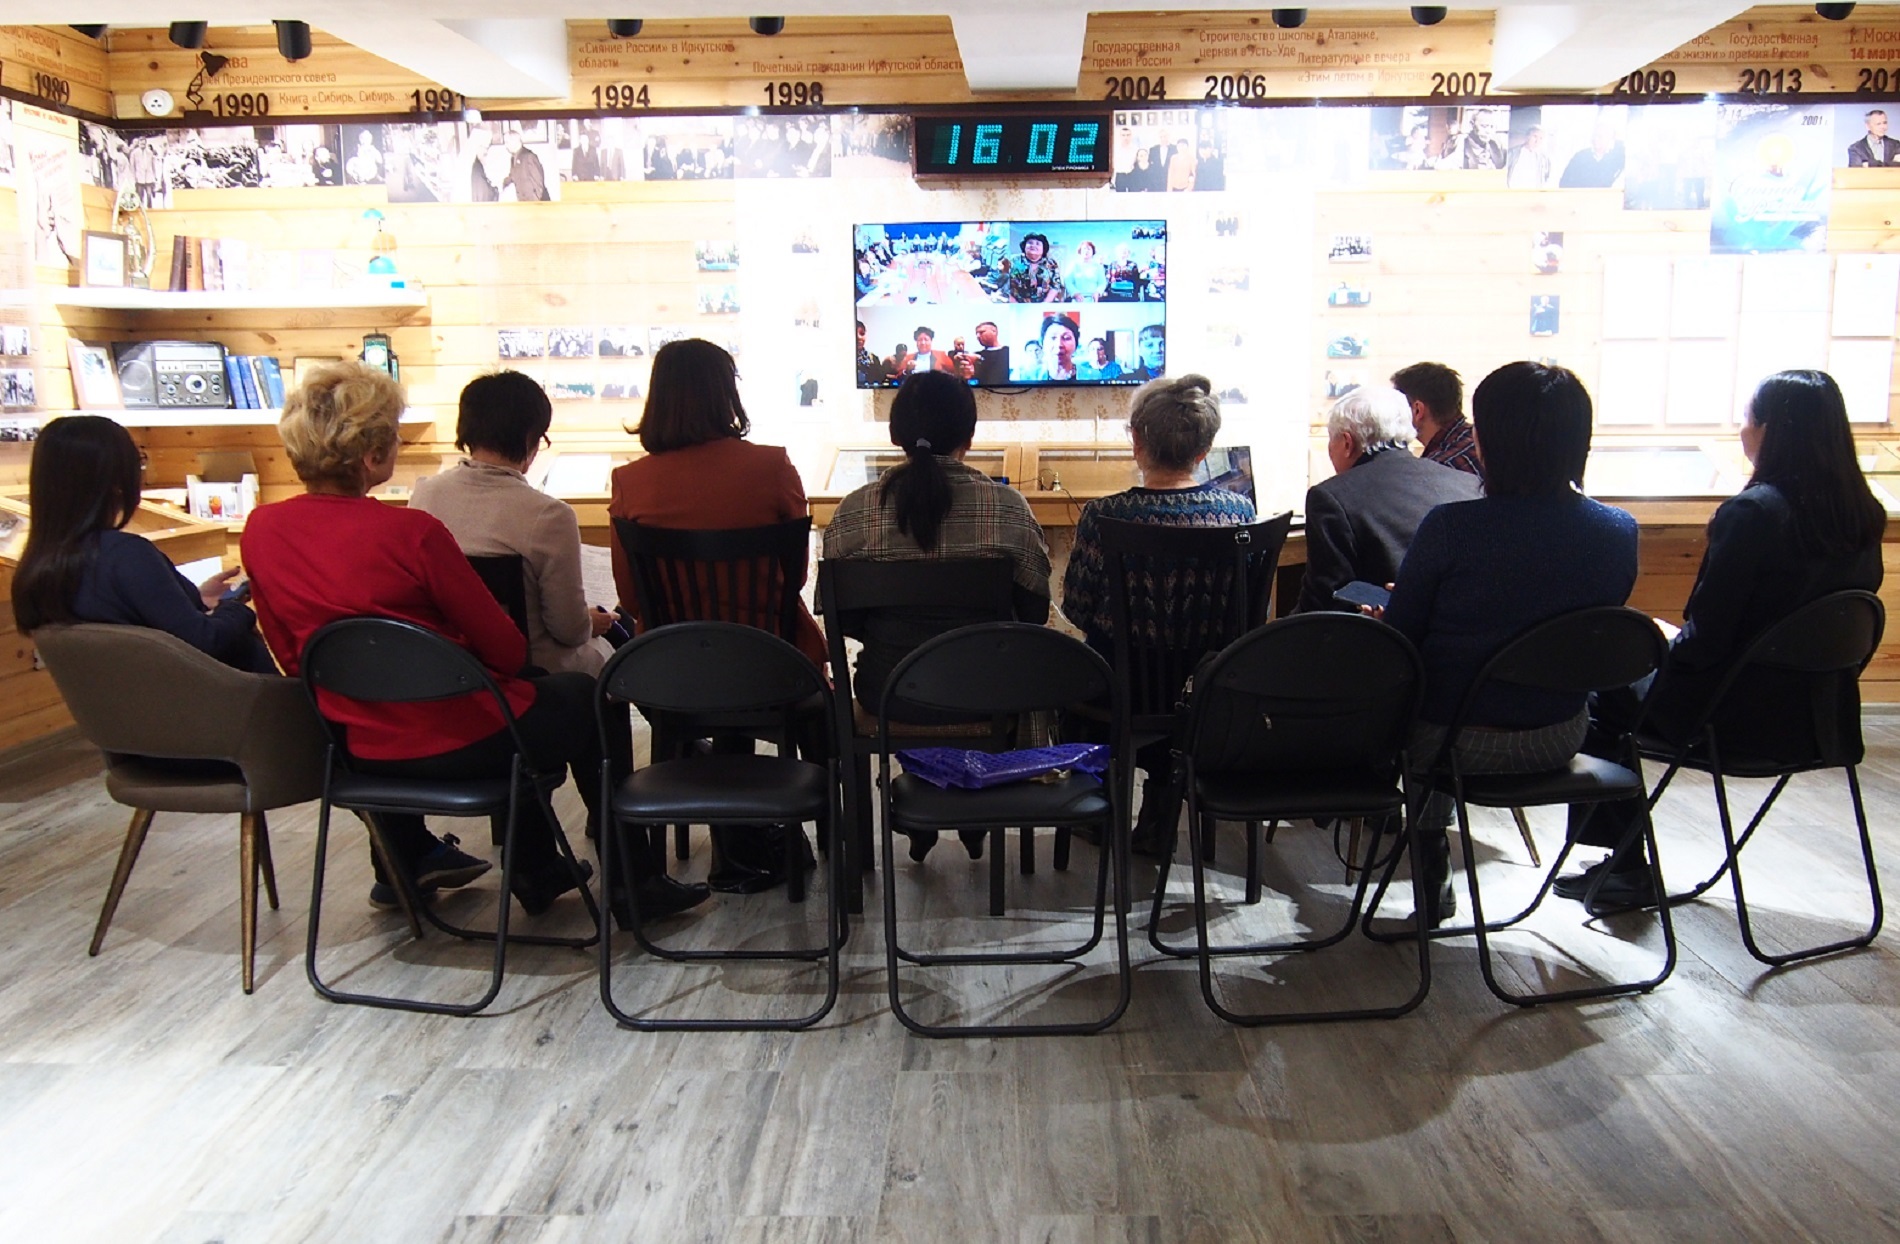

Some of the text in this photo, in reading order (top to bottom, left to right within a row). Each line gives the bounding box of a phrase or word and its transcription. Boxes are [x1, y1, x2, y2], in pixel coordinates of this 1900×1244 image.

[1200, 29, 1379, 43] Строительство школы в Аталанке,
[1864, 28, 1900, 42] Моск
[626, 41, 668, 53] России»
[672, 42, 678, 52] в
[682, 40, 736, 55] Иркутской
[1092, 40, 1180, 54] Государственная
[1200, 48, 1237, 59] церкви
[1240, 48, 1247, 57] в
[1297, 52, 1411, 65] Литературные вечера
[1729, 48, 1810, 62] премия России
[1850, 48, 1900, 61] 14 март
[579, 57, 620, 69] области
[753, 60, 802, 73] Почетный
[806, 60, 865, 73] гражданин
[868, 59, 921, 73] Иркутской
[1092, 56, 1172, 69] премия России
[200, 73, 337, 87] лен Президентского совета
[1334, 71, 1365, 82] летом
[1368, 72, 1374, 81] в
[1739, 68, 1803, 93] 2013
[1856, 67, 1900, 93] 201
[35, 71, 70, 106] 1989
[1104, 75, 1167, 100] 2004
[1204, 74, 1267, 100] 2006
[1430, 72, 1493, 96] 2007
[279, 92, 308, 105] Книга
[410, 87, 466, 112] 1991
[592, 84, 651, 109] 1994
[763, 81, 824, 106] 1998
[212, 92, 269, 116] 1990
[947, 123, 1099, 164] 16 02
